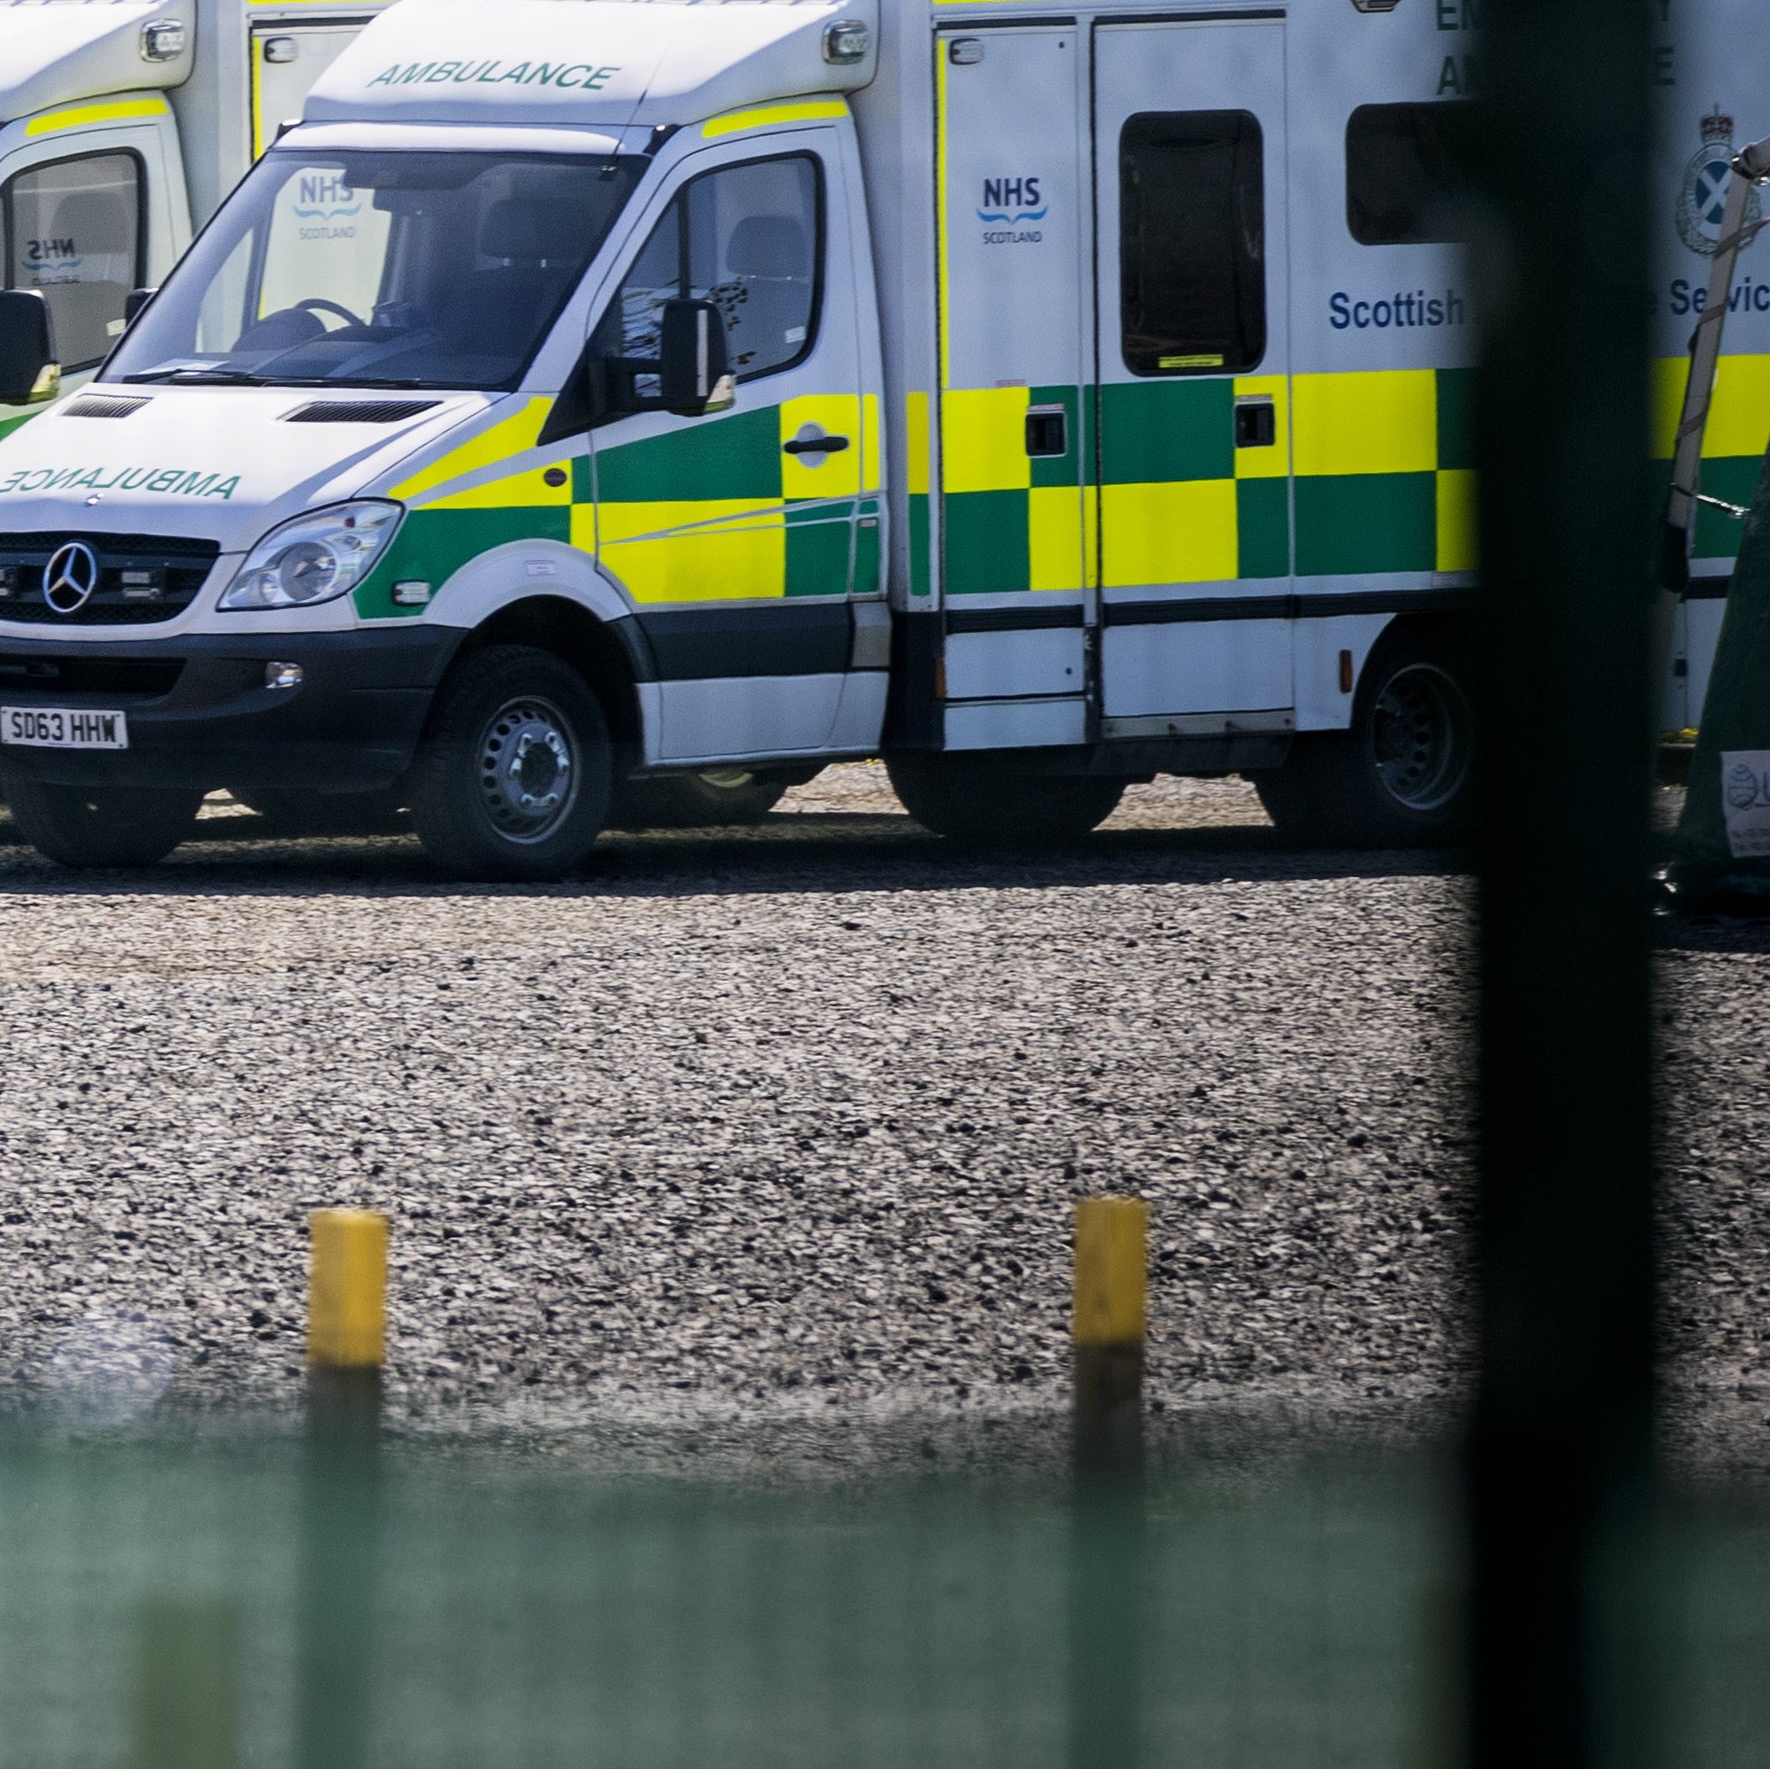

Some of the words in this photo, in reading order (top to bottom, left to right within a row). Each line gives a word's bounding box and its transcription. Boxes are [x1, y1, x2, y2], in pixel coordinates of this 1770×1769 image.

[366, 61, 621, 90] AMBULANCE
[984, 177, 1040, 207] NHS
[299, 226, 356, 240] SCOTLAND
[983, 231, 1043, 244] SCOTLAND
[1329, 290, 1463, 329] Scottish
[11, 711, 63, 741] SD63
[70, 713, 116, 743] HHW
